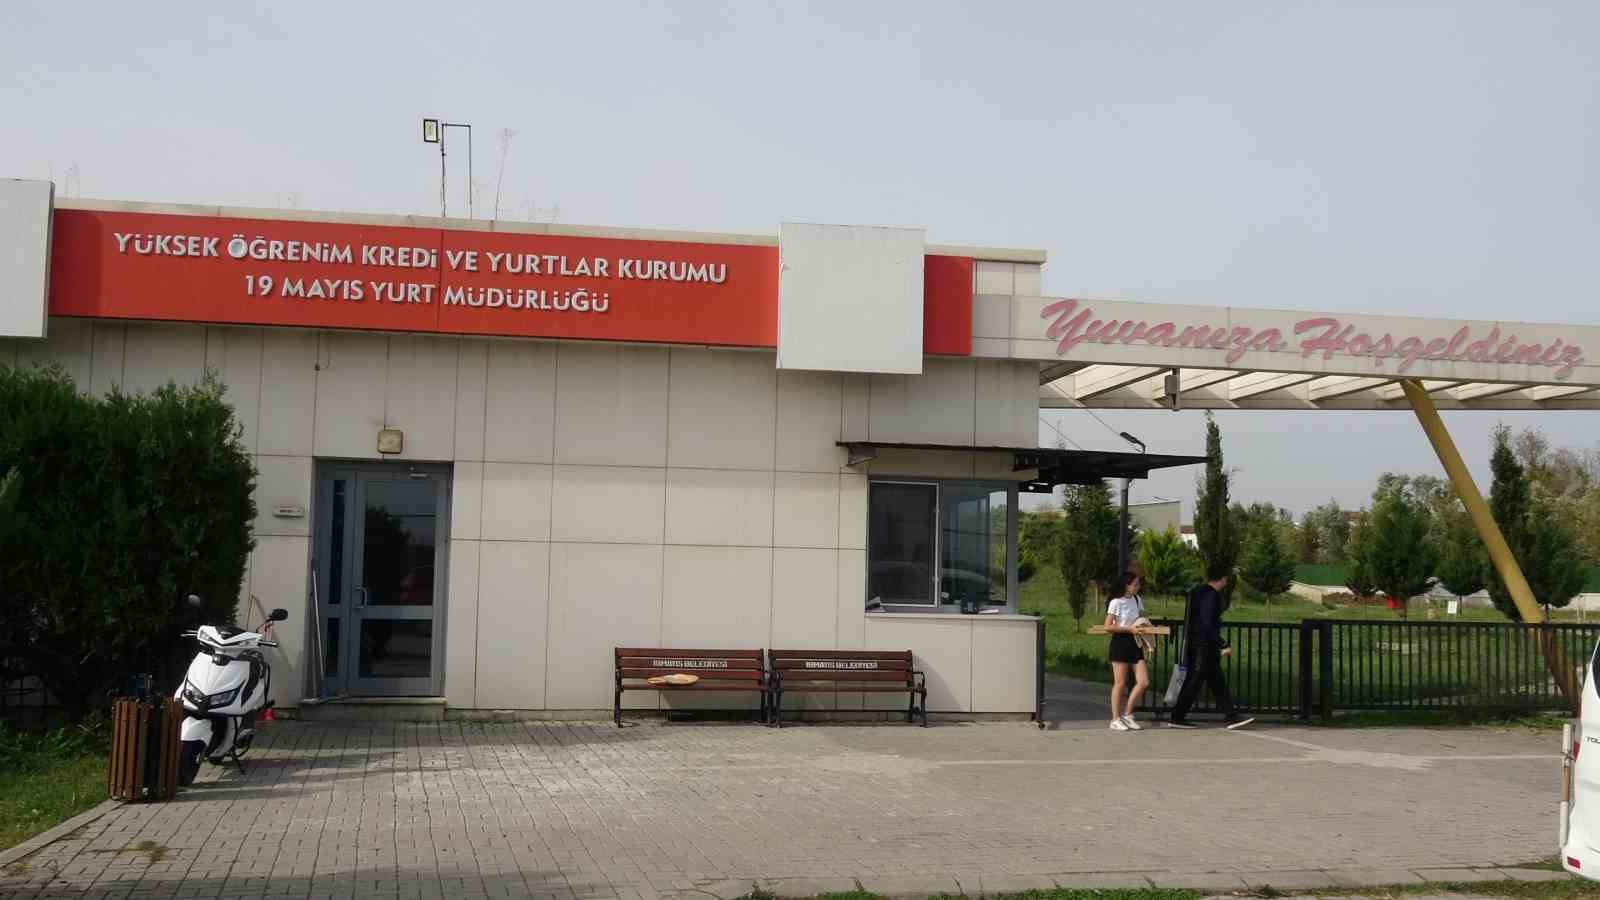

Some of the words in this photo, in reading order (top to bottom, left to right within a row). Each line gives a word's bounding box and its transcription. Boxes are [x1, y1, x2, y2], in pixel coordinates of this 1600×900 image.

[113, 232, 220, 257] YÜKSEK
[228, 234, 353, 264] ÖĞRENİM
[361, 244, 438, 269] KREDİ
[446, 250, 478, 272] VE
[486, 252, 609, 278] YURTLAR
[618, 258, 728, 284] KURUMU
[245, 274, 273, 297] 19
[282, 277, 364, 301] MAYIS
[370, 281, 436, 304] YURT
[443, 286, 610, 313] MÜDÜRLÜĞÜ
[1040, 299, 1288, 365] Yuvanıza
[1294, 317, 1585, 381] Hoşgeldiniz
